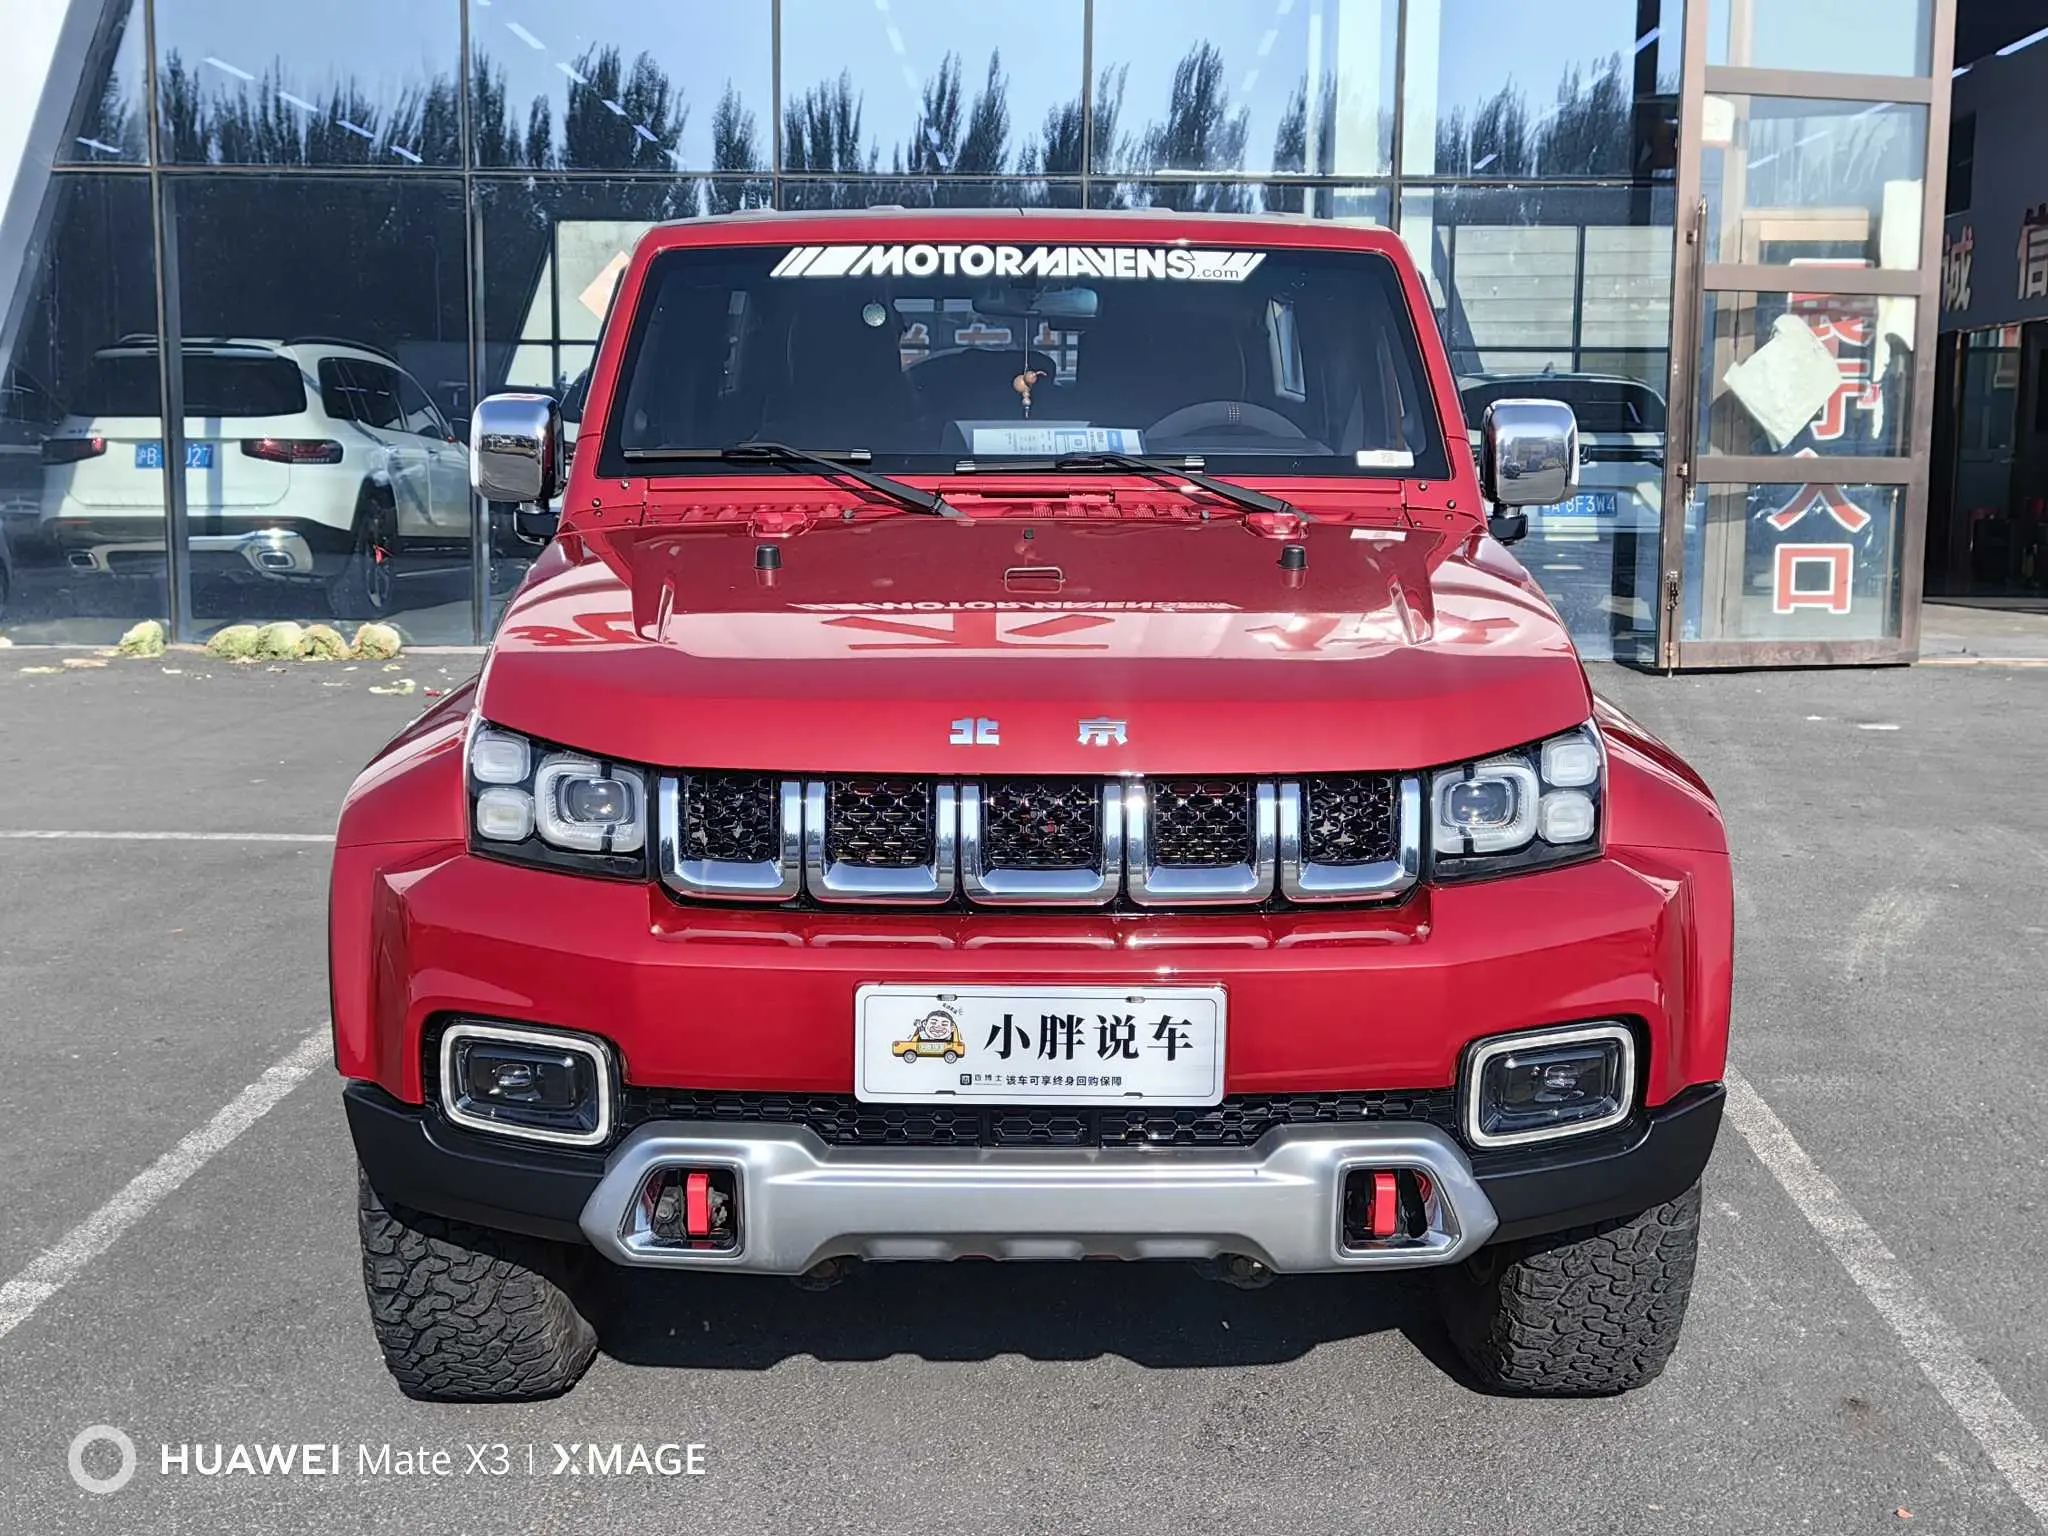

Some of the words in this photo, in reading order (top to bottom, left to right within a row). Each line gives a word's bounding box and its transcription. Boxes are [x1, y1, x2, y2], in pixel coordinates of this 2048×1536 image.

[949, 716, 1128, 746] 北京
[983, 1013, 1193, 1061] 小胖说车
[1005, 1074, 1122, 1087] 该车可享终身回购保障
